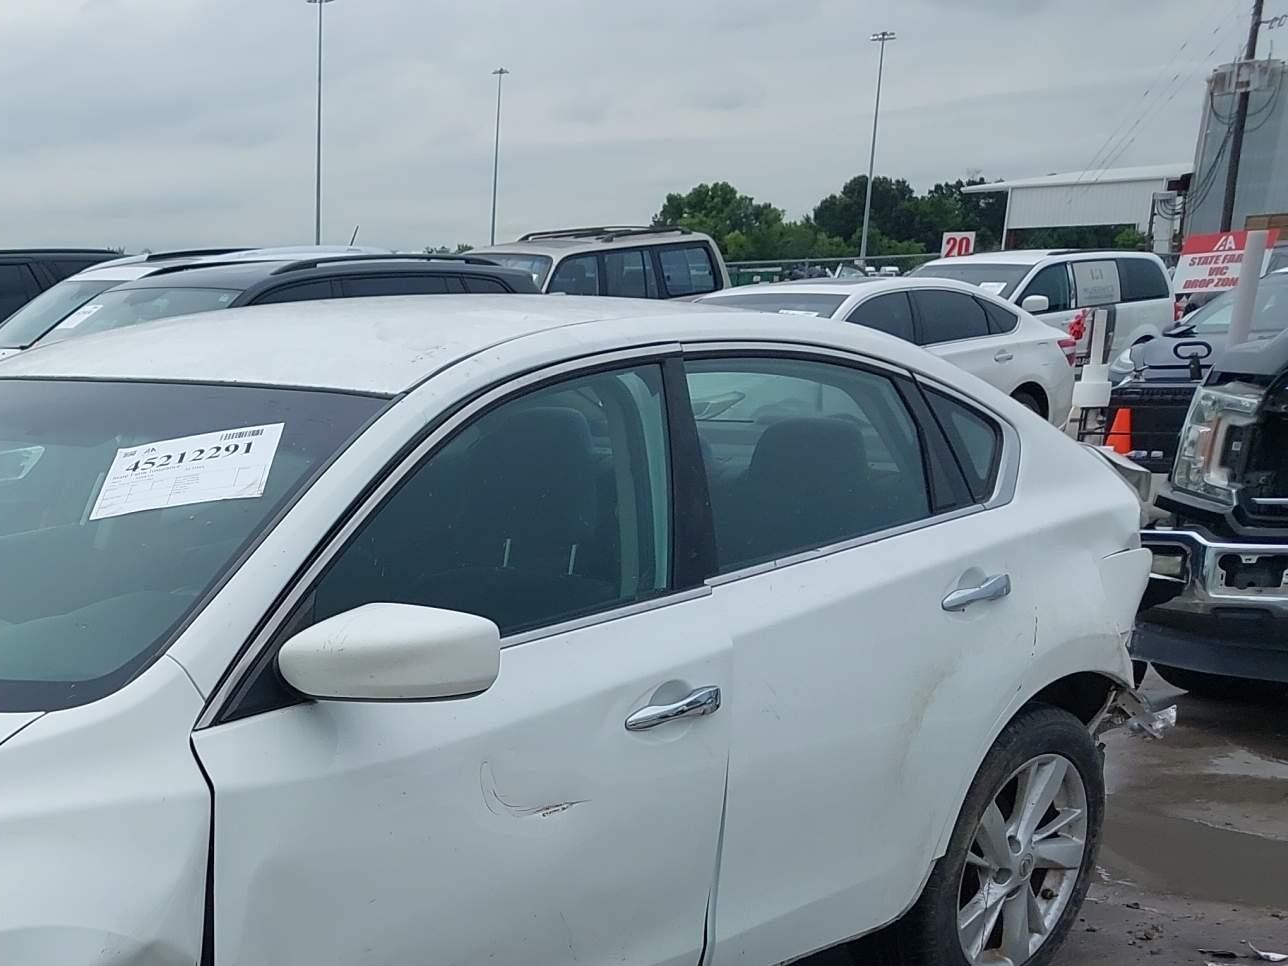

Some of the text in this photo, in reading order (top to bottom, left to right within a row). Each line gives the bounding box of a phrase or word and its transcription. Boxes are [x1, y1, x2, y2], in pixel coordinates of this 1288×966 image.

[944, 236, 970, 257] 20
[1189, 254, 1244, 266] STATE FAR
[1208, 266, 1229, 276] VIC
[1183, 277, 1240, 289] DROP ZON
[125, 441, 253, 473] 45212291
